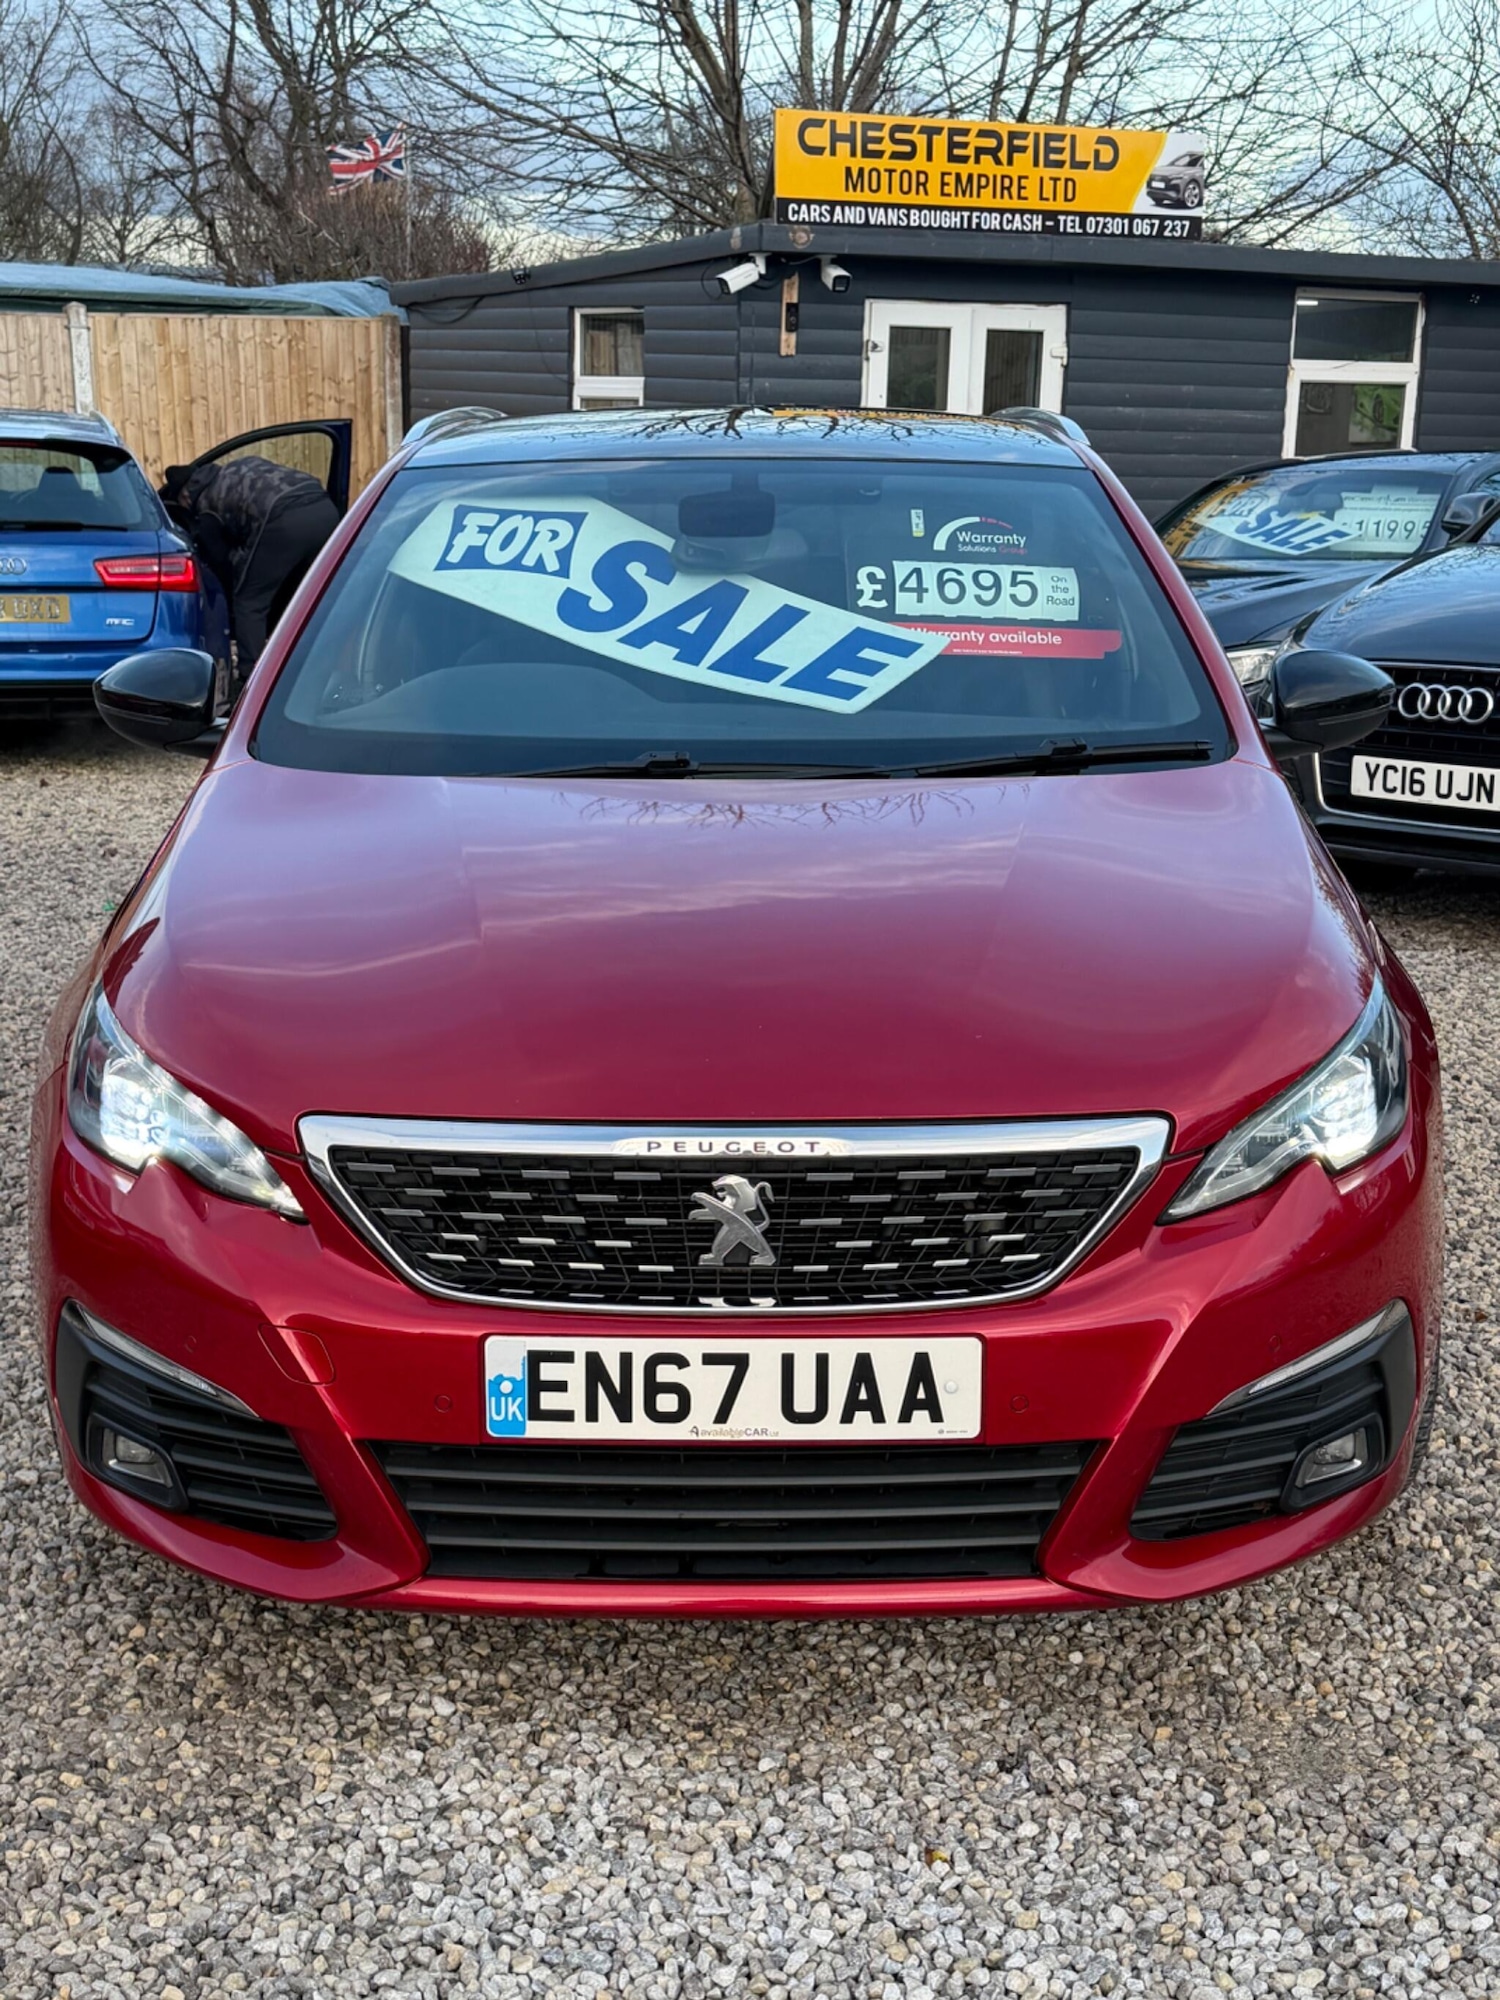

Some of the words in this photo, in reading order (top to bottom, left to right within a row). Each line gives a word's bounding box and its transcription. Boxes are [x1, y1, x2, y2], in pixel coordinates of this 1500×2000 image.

[797, 117, 1120, 172] CHESTERFIELD
[844, 166, 929, 197] MOTOR
[939, 171, 1030, 201] EMPIRE
[1039, 176, 1077, 203] LTD
[788, 203, 831, 223] CARS
[833, 205, 866, 225] AND
[867, 207, 909, 227] VANS
[909, 209, 971, 229] BOUGHT
[971, 212, 1001, 231] FOR
[1002, 212, 1043, 232] CASH
[1057, 215, 1083, 234] TEL
[1086, 216, 1129, 235] 07301
[1132, 218, 1160, 237] 067
[1163, 219, 1190, 238] 237
[956, 531, 1026, 548] Warranty
[1234, 504, 1353, 551] SALE
[957, 544, 997, 553] Solutions
[1050, 575, 1067, 583] On
[1051, 585, 1069, 594] the
[444, 511, 575, 574] FOR
[556, 540, 926, 702] SALE
[1046, 595, 1075, 606] Road
[911, 628, 985, 645] ranty
[989, 631, 1062, 645] available
[1365, 762, 1426, 797] YC16
[1435, 769, 1495, 804] UJN
[646, 1141, 820, 1153] PEUGEOT
[526, 1349, 750, 1424] EN67
[780, 1351, 945, 1424] UAA
[489, 1396, 524, 1422] UK
